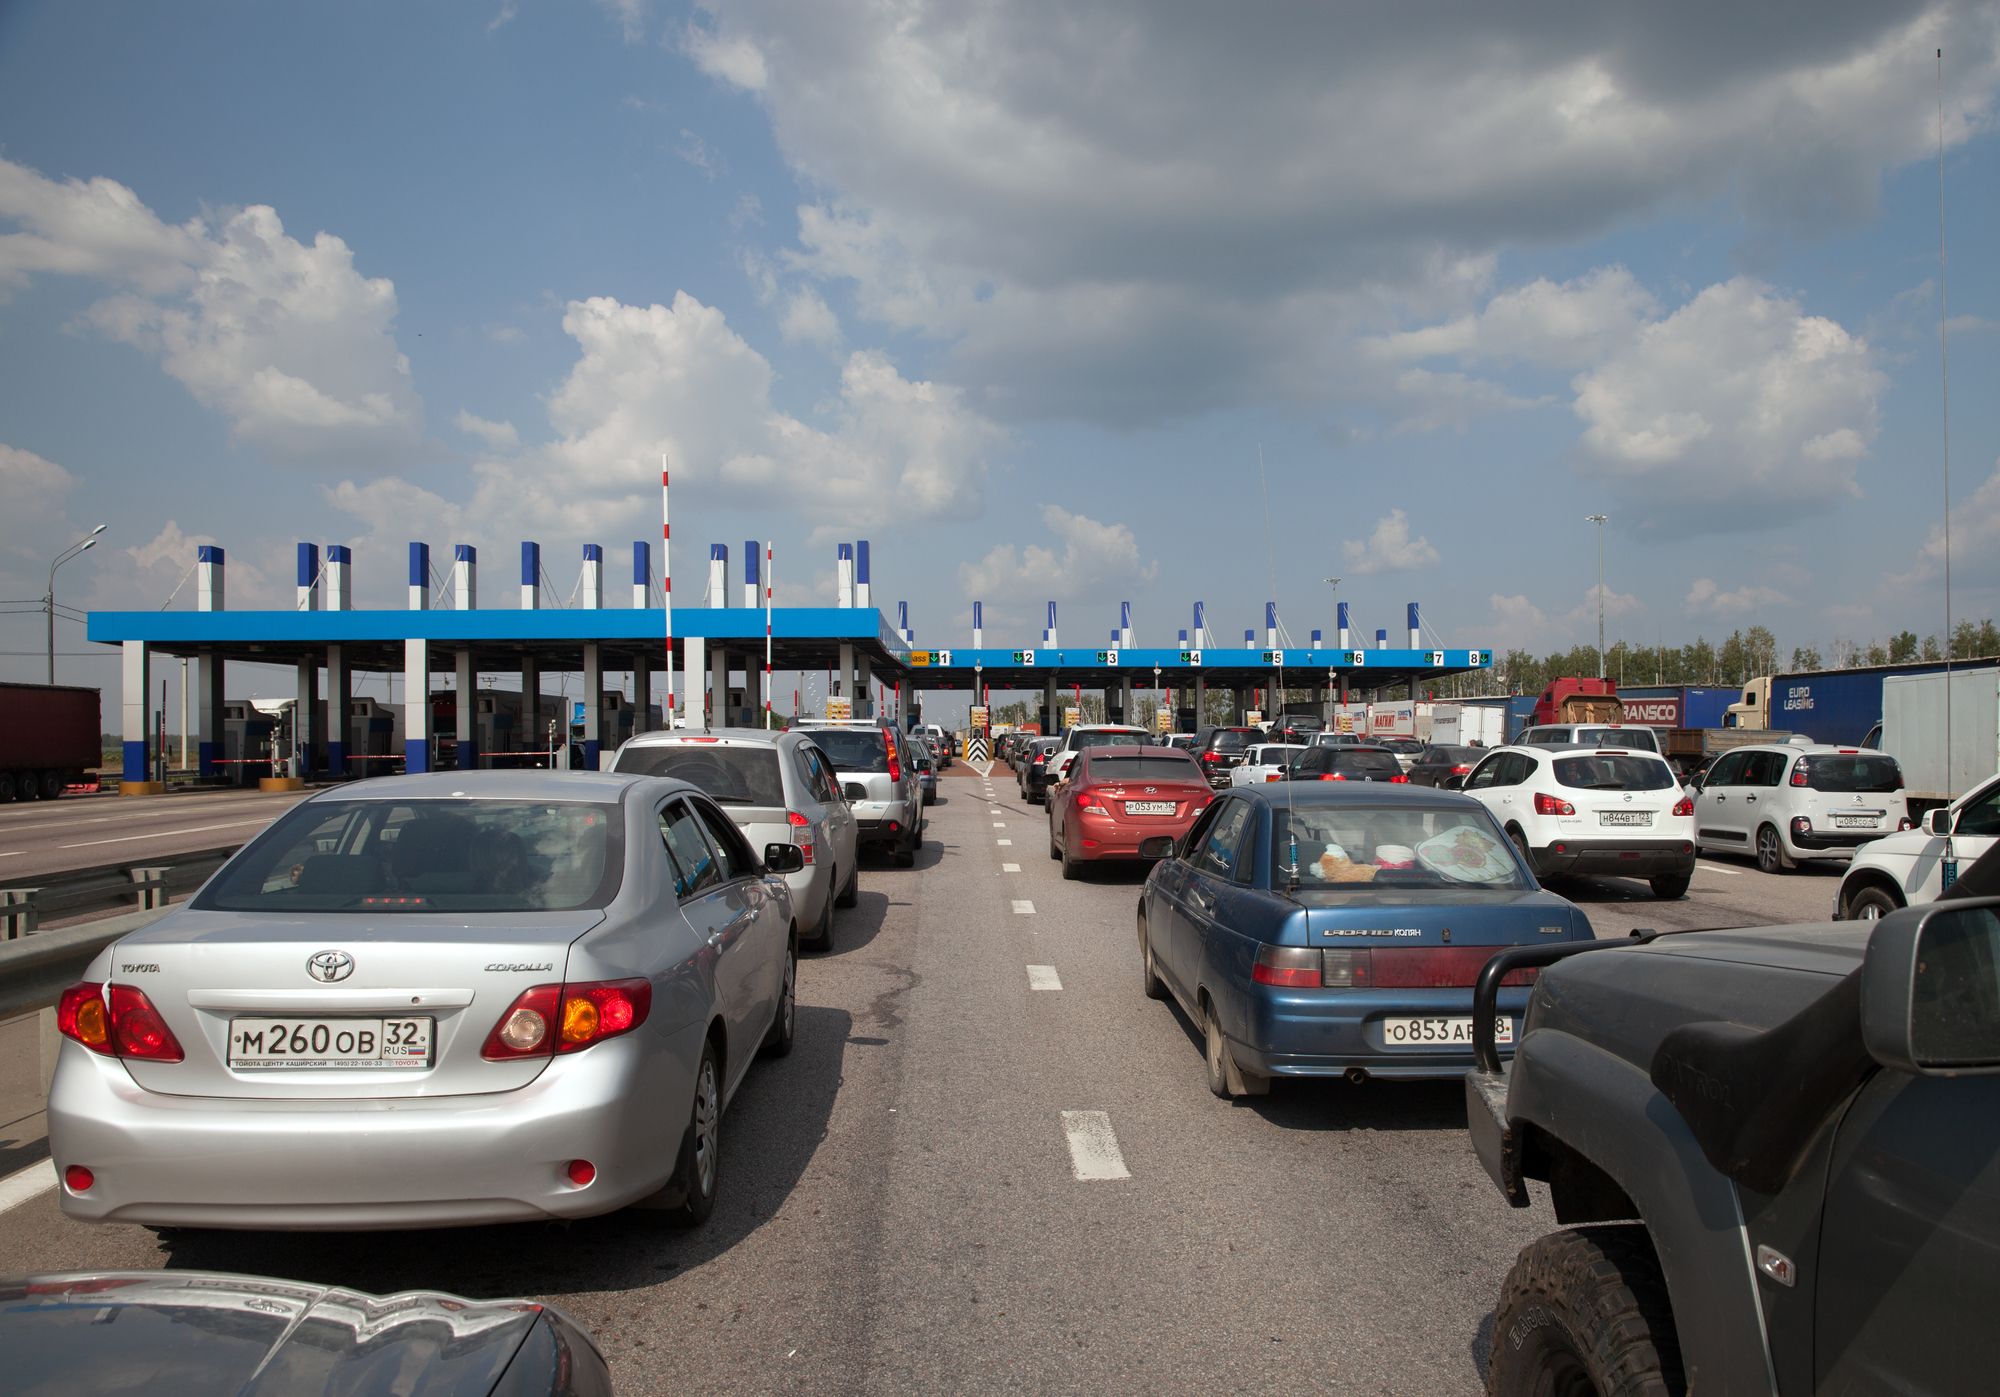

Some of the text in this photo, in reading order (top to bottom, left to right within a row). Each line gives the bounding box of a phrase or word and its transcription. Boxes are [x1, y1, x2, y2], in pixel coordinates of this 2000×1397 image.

[941, 653, 947, 663] 1
[1025, 653, 1033, 663] 2
[1109, 653, 1116, 663] 3
[1192, 653, 1200, 663] 4
[1274, 653, 1281, 663] 5
[1355, 653, 1363, 663] 6
[1435, 653, 1442, 663] 7
[1470, 653, 1478, 663] 8
[1789, 686, 1810, 698] EURO
[1783, 699, 1814, 710] LEASING
[1623, 704, 1676, 720] RANSCO
[121, 964, 161, 973] TOYOTA
[484, 963, 553, 972] COROLLA
[386, 1022, 418, 1045] 32
[384, 1046, 408, 1055] RUS
